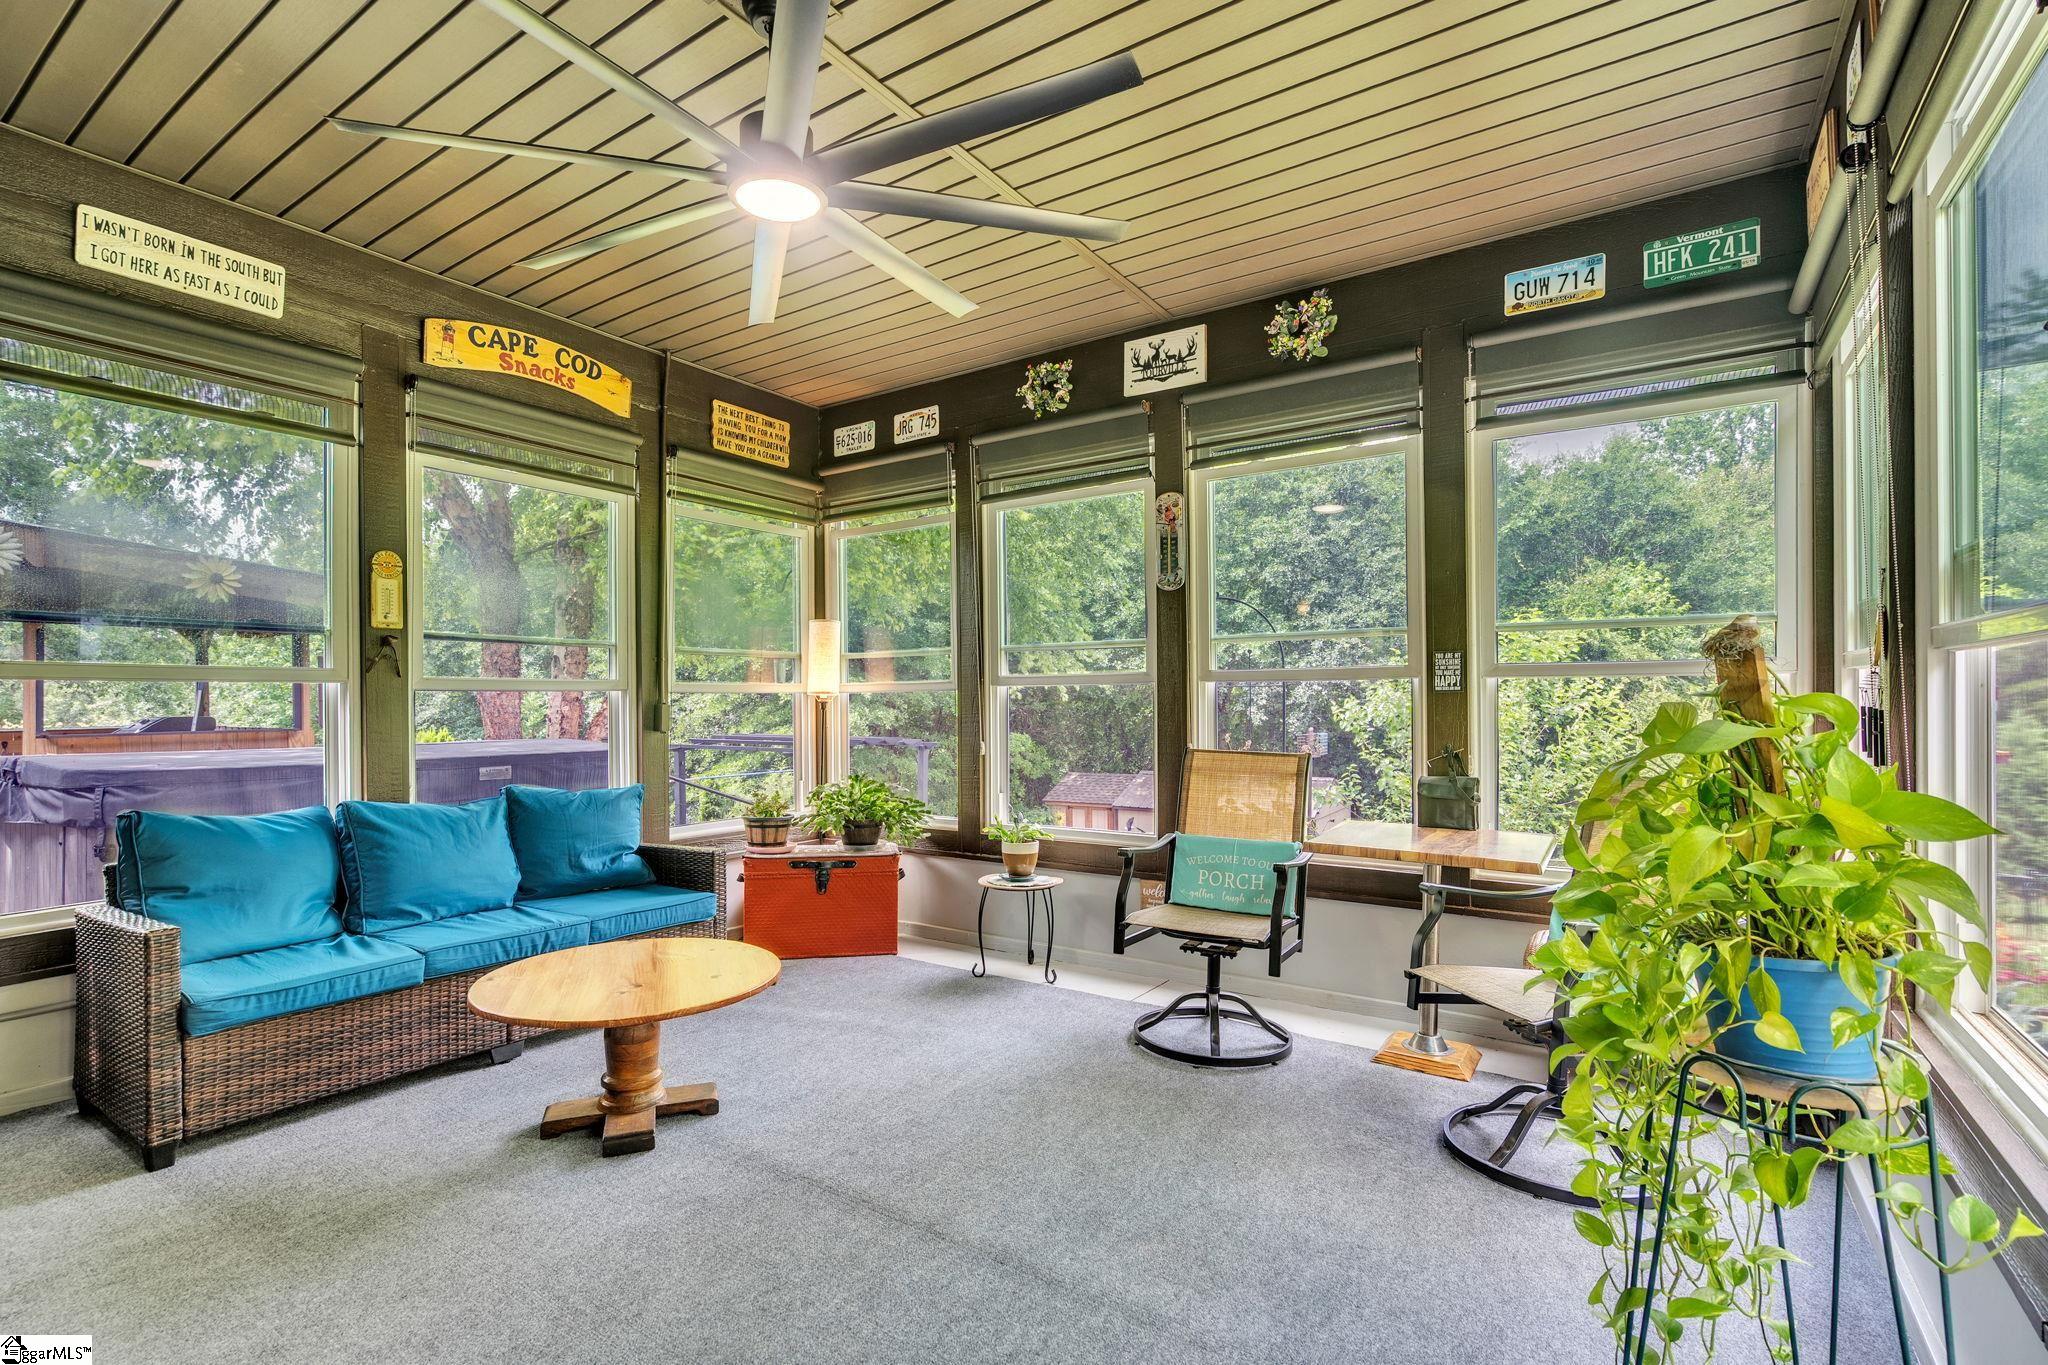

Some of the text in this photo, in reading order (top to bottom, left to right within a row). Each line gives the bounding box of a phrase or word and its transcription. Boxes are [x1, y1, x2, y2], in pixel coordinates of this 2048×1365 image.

[1676, 226, 1724, 243] Vermont
[82, 212, 283, 287] I WASN'T BORN IN THE SOUTH BUT
[1653, 232, 1751, 275] HFK 241
[90, 243, 279, 311] I GOT HERE AS FAST AS I COULD
[1514, 266, 1596, 301] GUW 714
[467, 325, 603, 381] CAPE COD
[498, 352, 576, 390] Snacks
[718, 405, 728, 415] THE
[729, 408, 743, 420] NEXT
[761, 418, 776, 430] THING
[778, 423, 785, 431] TO
[718, 416, 742, 430] HAVING
[745, 423, 756, 434] YOU
[758, 428, 768, 437] FOR
[769, 431, 774, 439] A
[896, 412, 937, 436] JRG 745
[716, 437, 732, 449] HAVE
[734, 442, 745, 452] YOU
[746, 447, 757, 455] FOR
[756, 449, 762, 457] A
[841, 428, 872, 448] 625-016
[1435, 676, 1461, 687] HAPPY
[1186, 854, 1274, 871] WELCOME TO OU
[1197, 869, 1265, 891] PORCH
[1221, 890, 1245, 905] laugh
